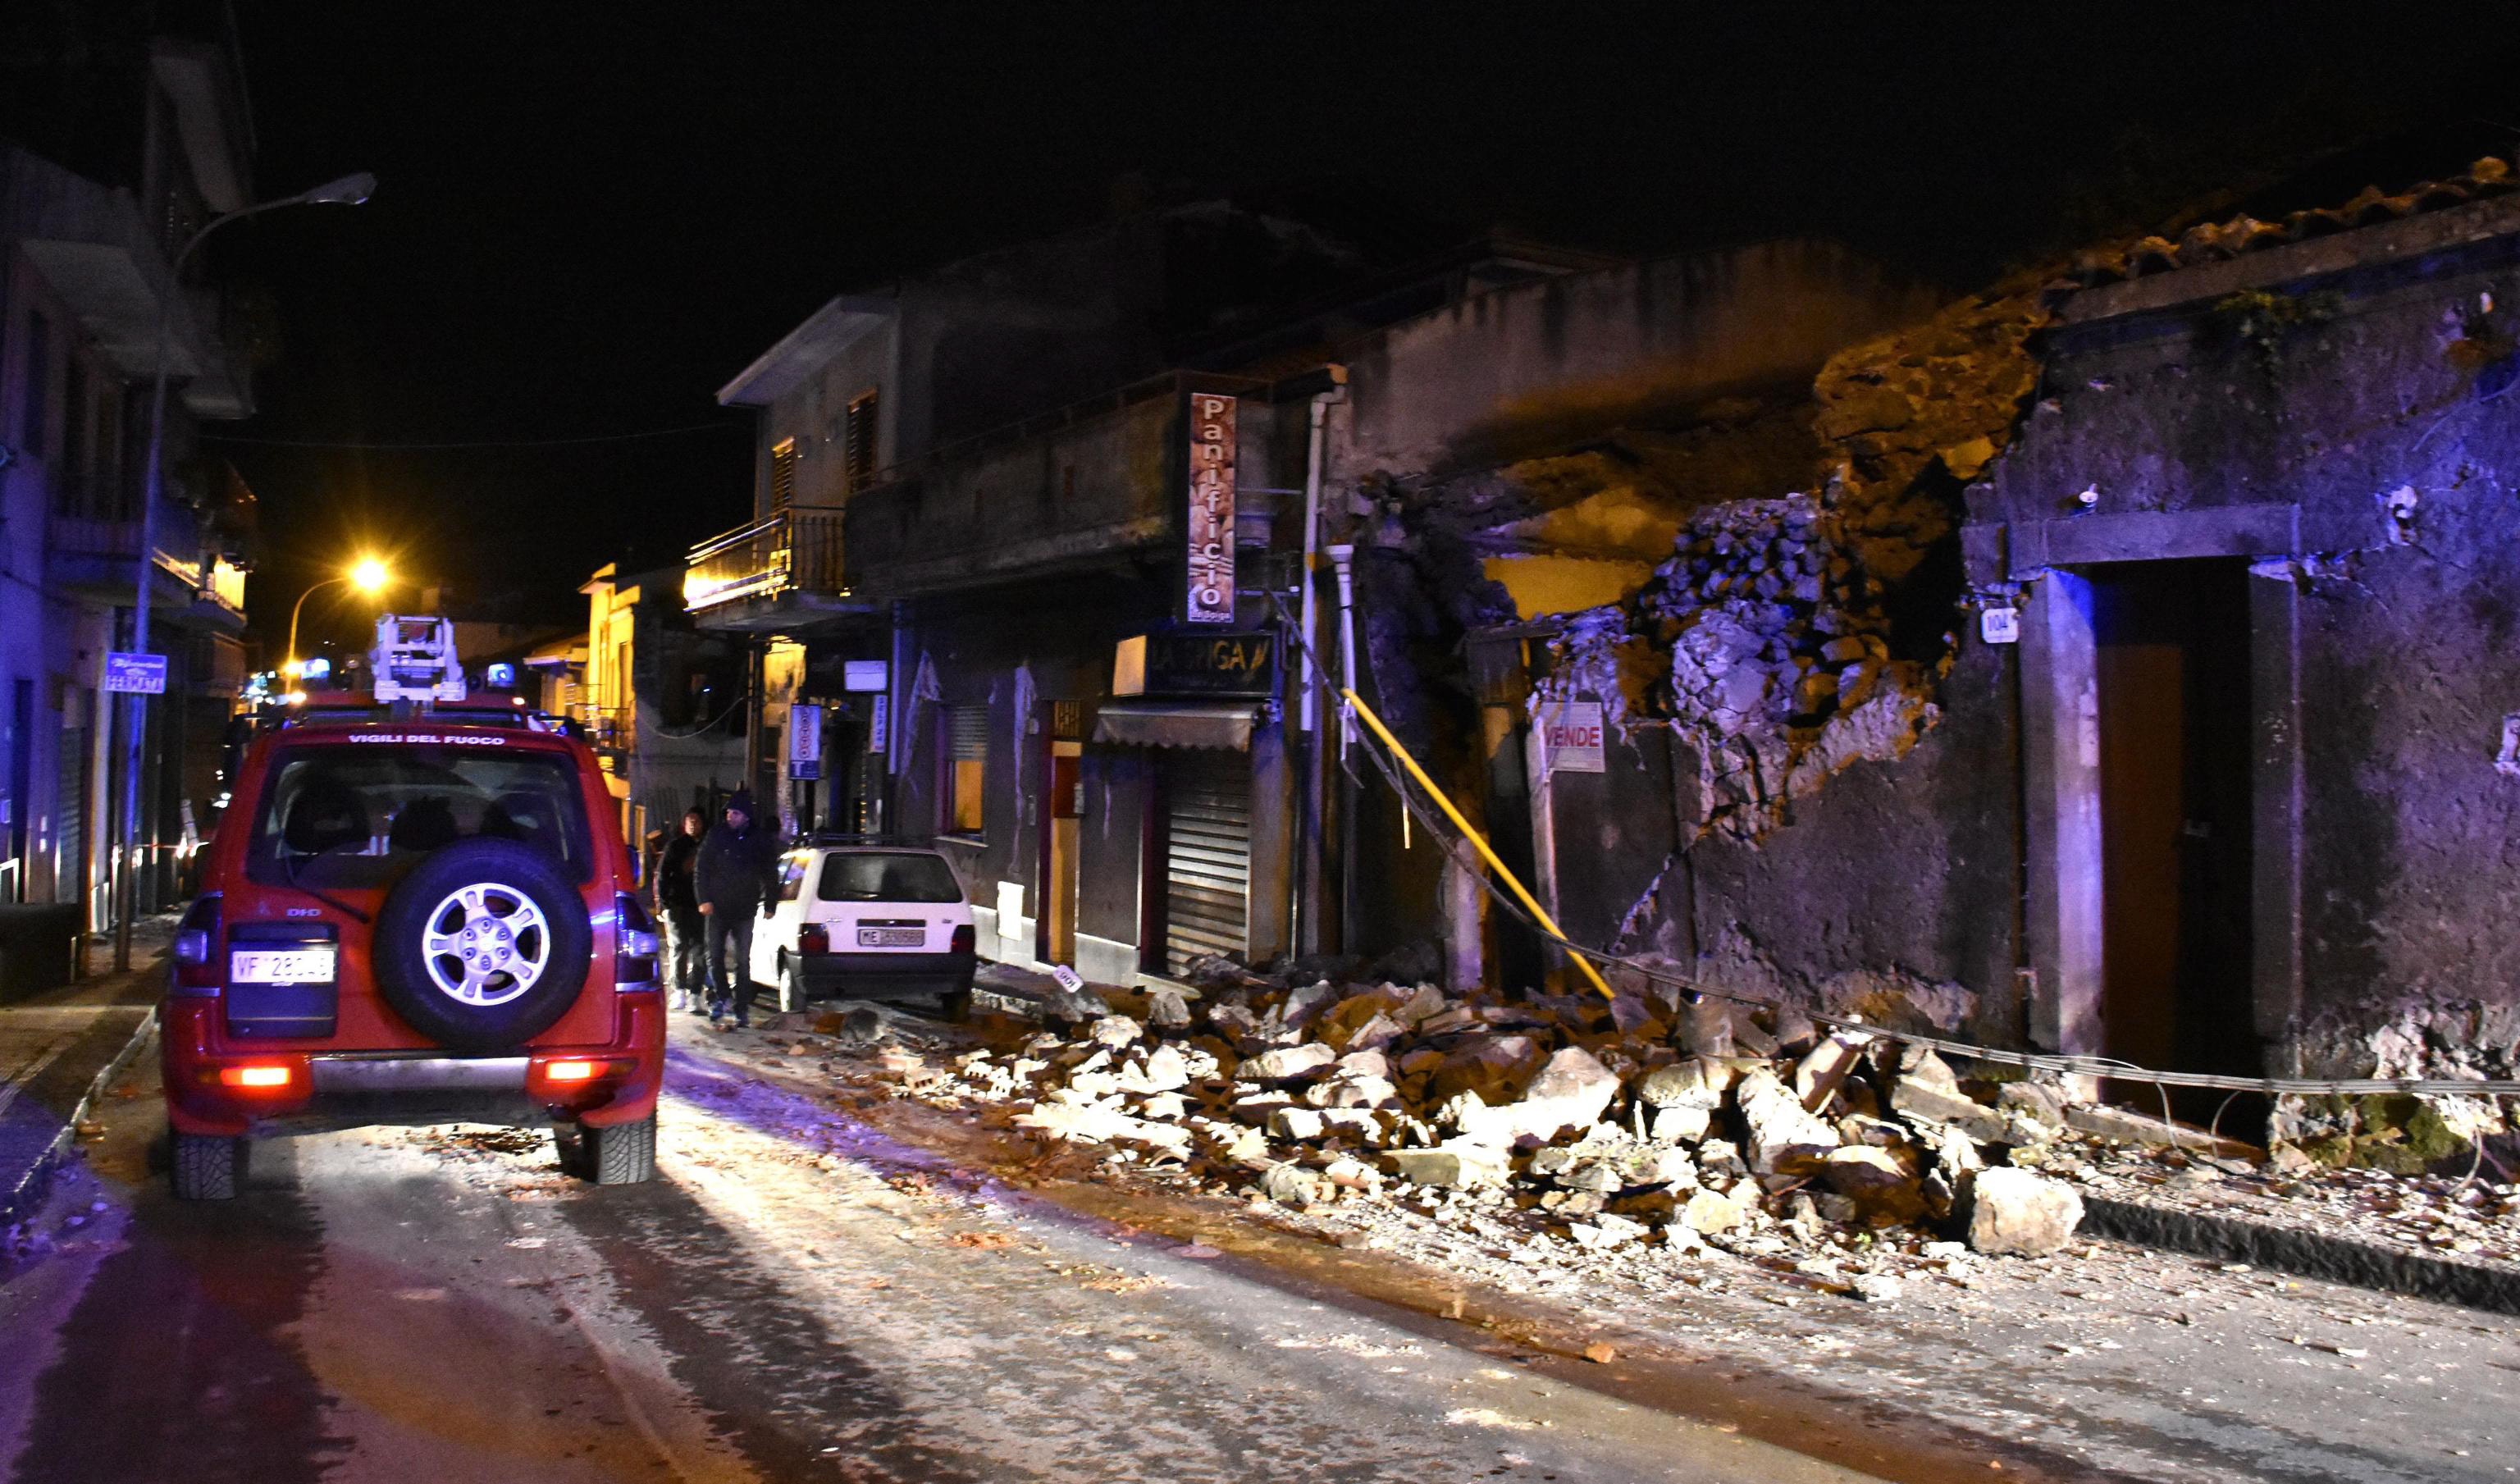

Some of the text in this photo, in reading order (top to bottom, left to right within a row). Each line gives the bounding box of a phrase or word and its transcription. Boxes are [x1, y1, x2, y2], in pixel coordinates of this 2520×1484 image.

[1202, 399, 1225, 605] Panificio
[349, 734, 505, 746] VIGILI DEL FUOCO
[1544, 726, 1600, 747] VENDE
